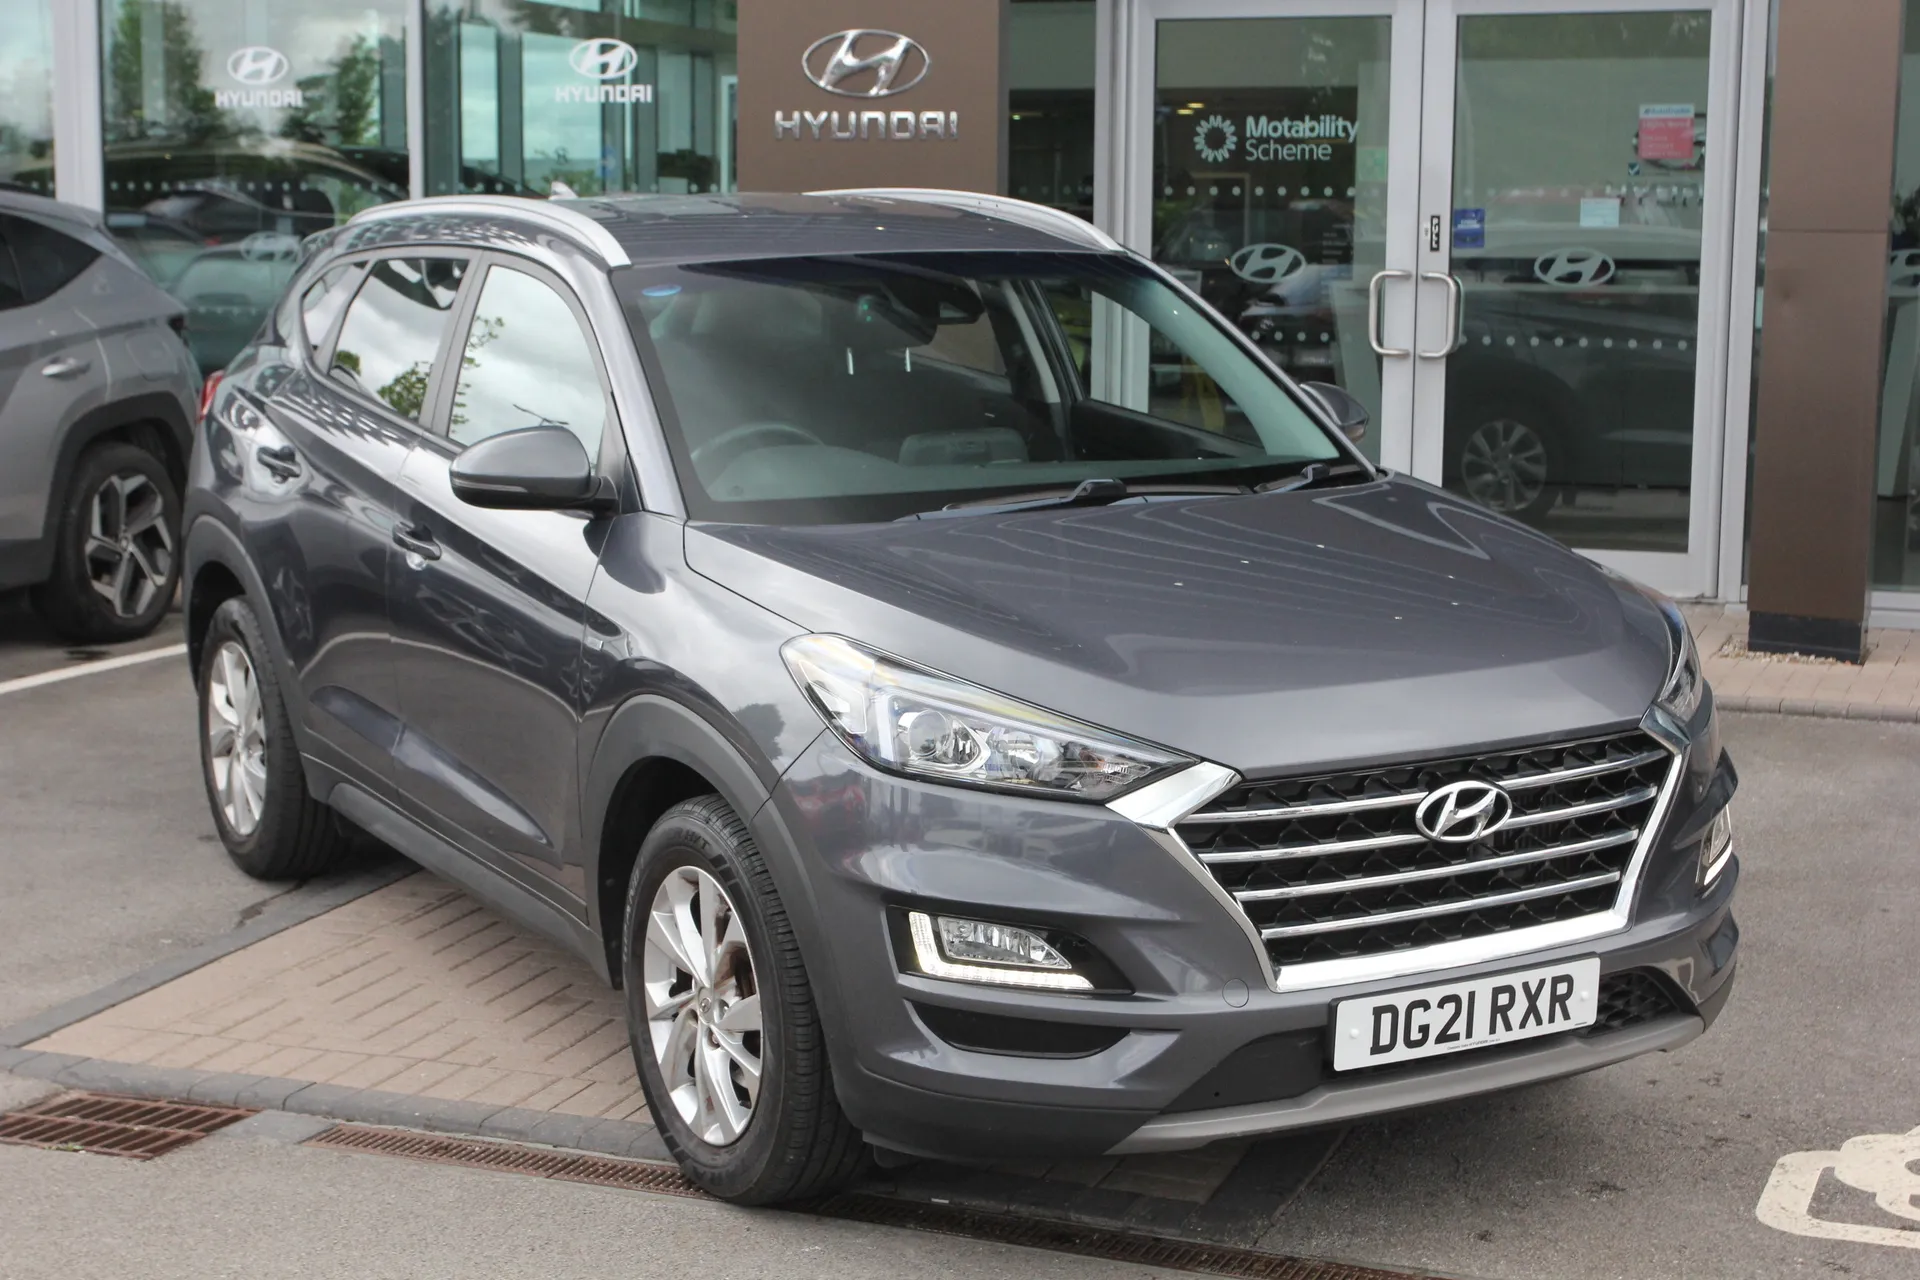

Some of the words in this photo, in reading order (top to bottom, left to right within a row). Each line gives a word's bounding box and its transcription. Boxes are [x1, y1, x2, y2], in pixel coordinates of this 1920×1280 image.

[215, 90, 303, 108] HYUNDAI
[554, 84, 653, 103] HYUNDAI
[774, 110, 958, 139] HYUNDAI
[1246, 115, 1359, 143] Motability
[1245, 139, 1332, 161] Scheme
[1370, 990, 1476, 1056] DG21
[1489, 973, 1574, 1035] RXR
